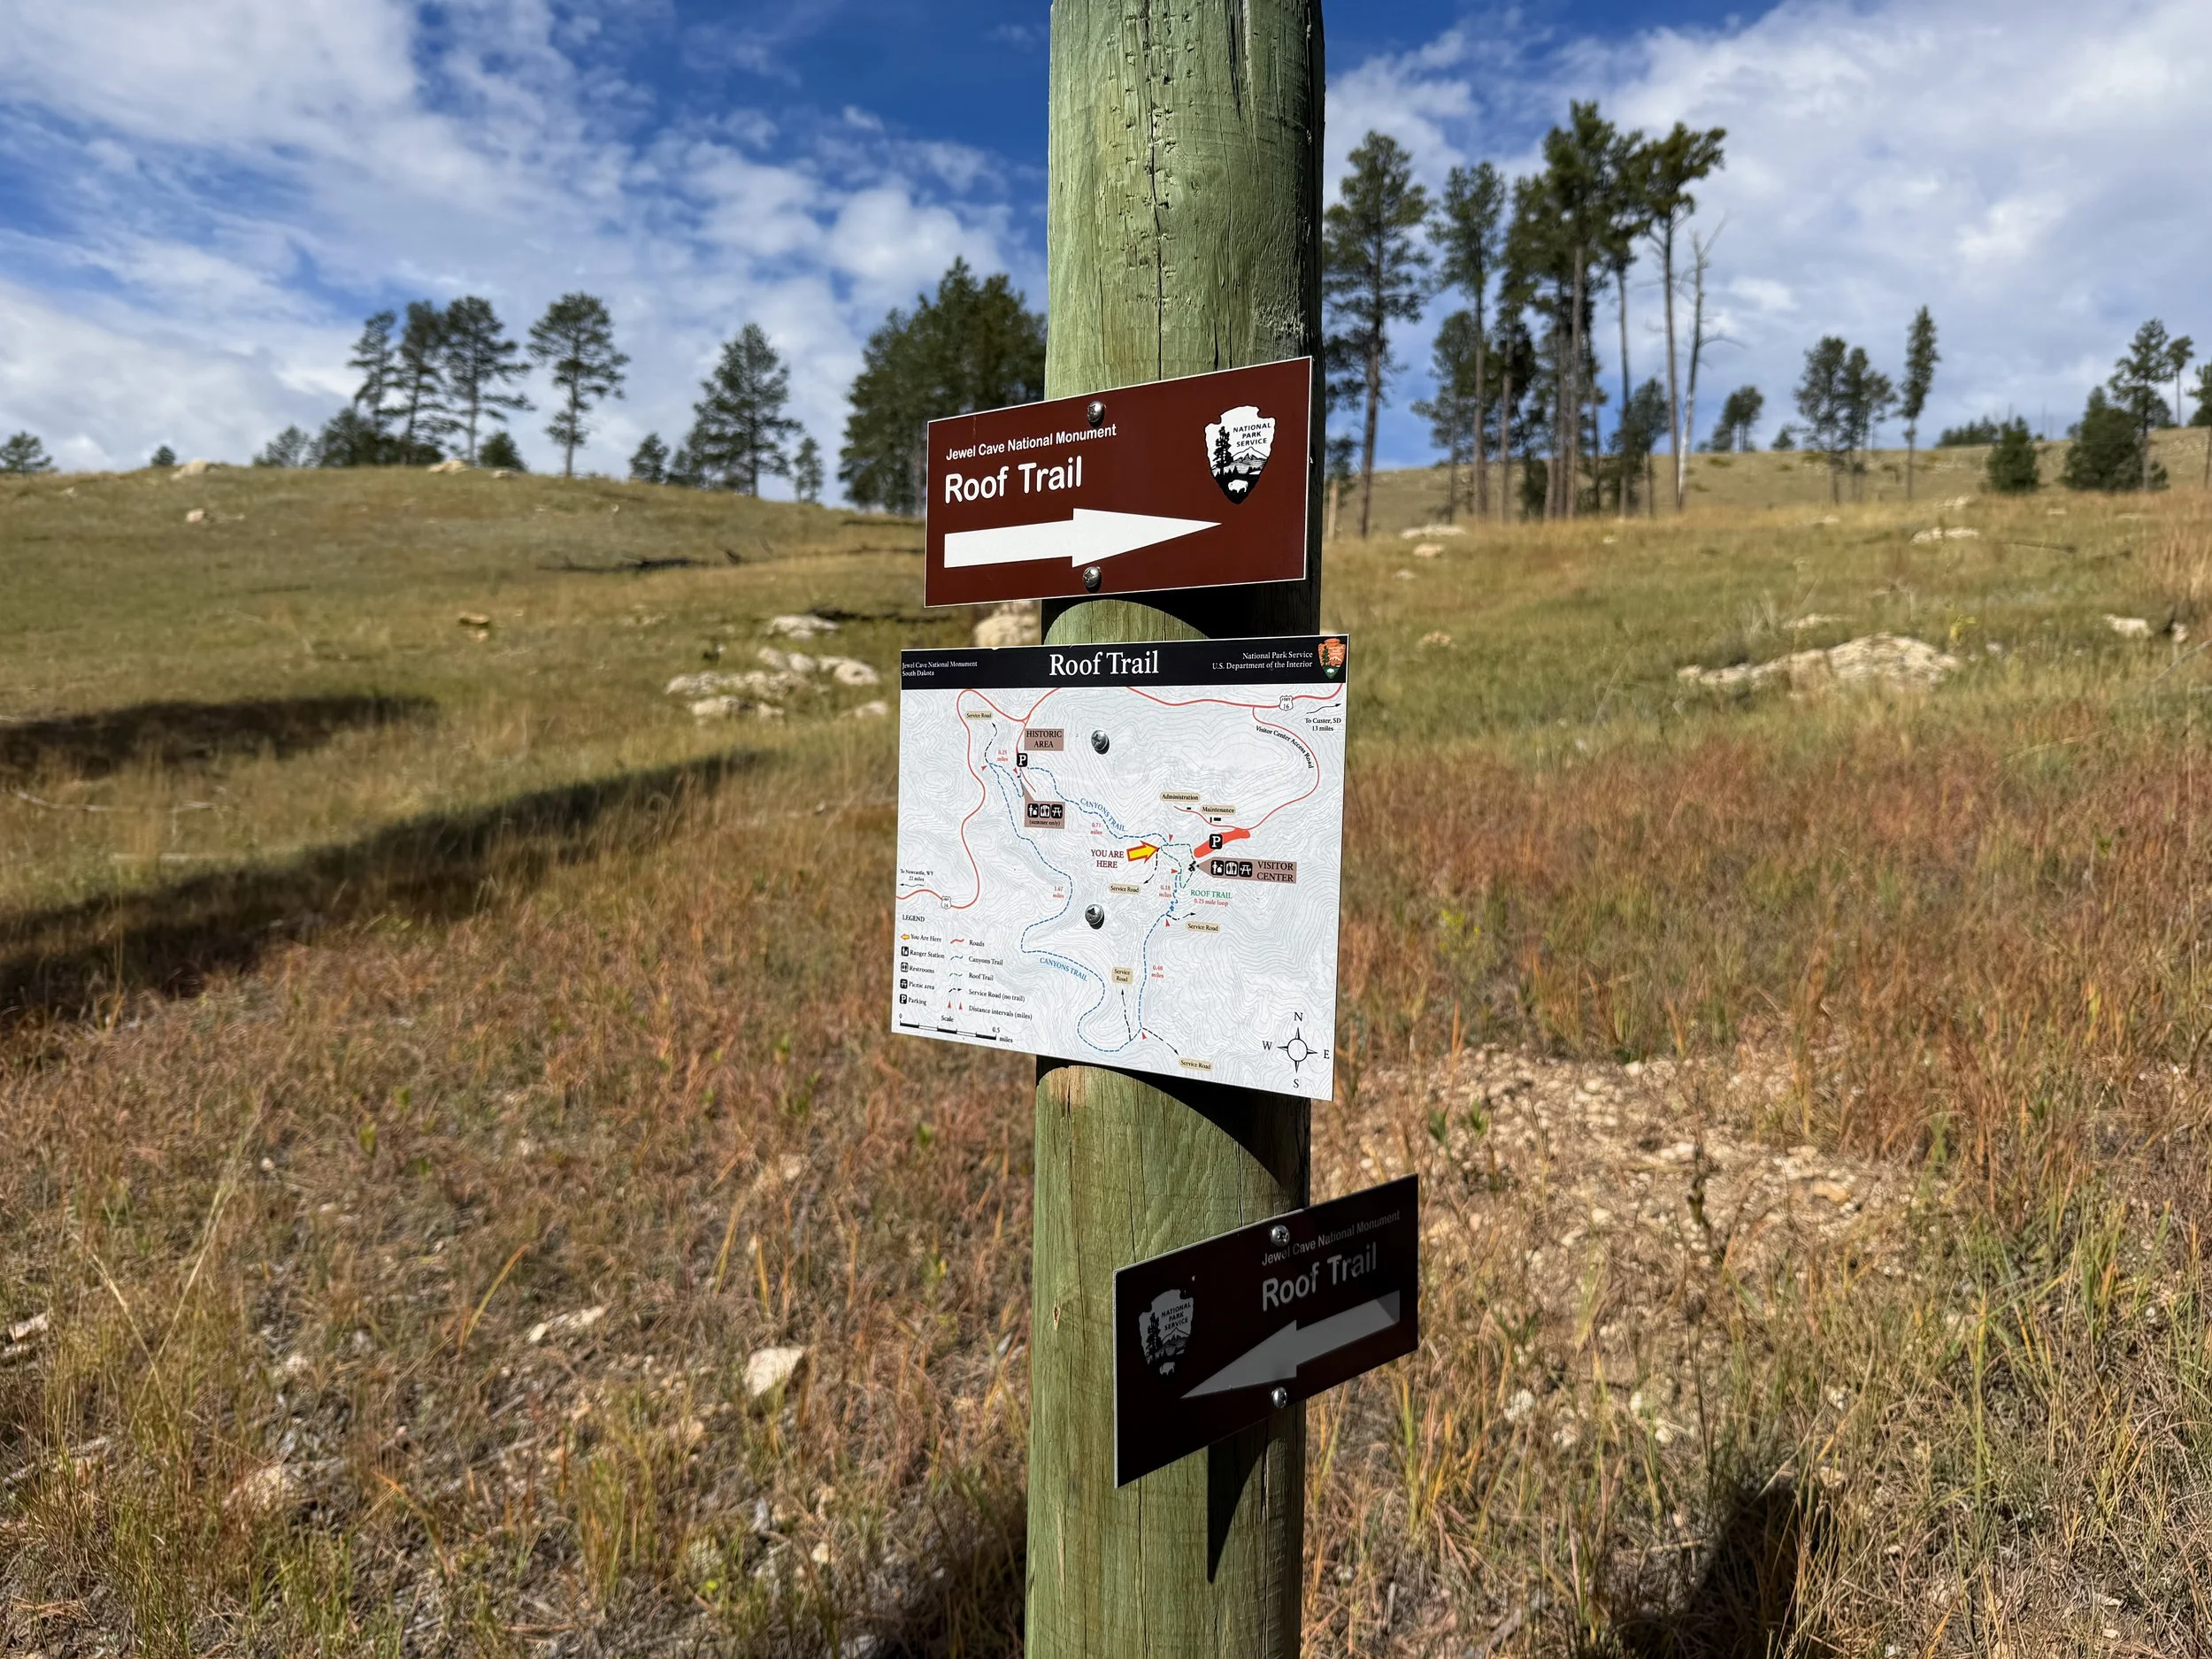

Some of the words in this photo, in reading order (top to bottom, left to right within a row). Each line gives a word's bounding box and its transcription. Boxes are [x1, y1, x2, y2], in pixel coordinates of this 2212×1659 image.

[1233, 422, 1271, 434] NATIONAL
[946, 447, 975, 461] Jewel
[979, 441, 1005, 457] Cave
[1008, 434, 1053, 453] National
[1056, 424, 1117, 445] Monument
[1236, 438, 1268, 447] SERVICE
[945, 467, 1010, 504] Roof
[1018, 457, 1082, 494] Trail
[1049, 651, 1103, 676] Roof
[1106, 649, 1159, 674] Trail
[1226, 662, 1265, 671] Department
[1256, 726, 1272, 734] Visitor
[1274, 730, 1291, 741] Center
[1291, 739, 1306, 754] Access
[1304, 752, 1314, 769] Road
[1080, 798, 1110, 818] CANYONS
[1109, 816, 1126, 832] TRAIL
[1257, 861, 1294, 871] VISITOR
[1256, 872, 1294, 882] CENTER
[969, 956, 990, 964] Canyons
[1040, 957, 1070, 972] CANYONS
[1070, 968, 1088, 982] TRAIL
[908, 997, 926, 1006] Parking
[969, 1005, 990, 1014] Distance
[991, 1008, 1014, 1018] intervals
[1015, 1011, 1033, 1020] (miles)
[1294, 1011, 1303, 1022] N
[1262, 1041, 1272, 1050] W
[1324, 1049, 1330, 1059] E
[1180, 1059, 1198, 1068] Service
[1293, 1079, 1300, 1088] S
[1262, 1248, 1290, 1266] Jewel
[1293, 1240, 1316, 1256] Cave
[1318, 1227, 1355, 1248] National
[1356, 1210, 1400, 1237] Monument
[1262, 1262, 1319, 1311] Roof
[1327, 1242, 1377, 1286] Trail
[1161, 1302, 1192, 1317] NATIONAL
[1169, 1312, 1184, 1322] PARK
[1164, 1317, 1189, 1331] SERVICE
